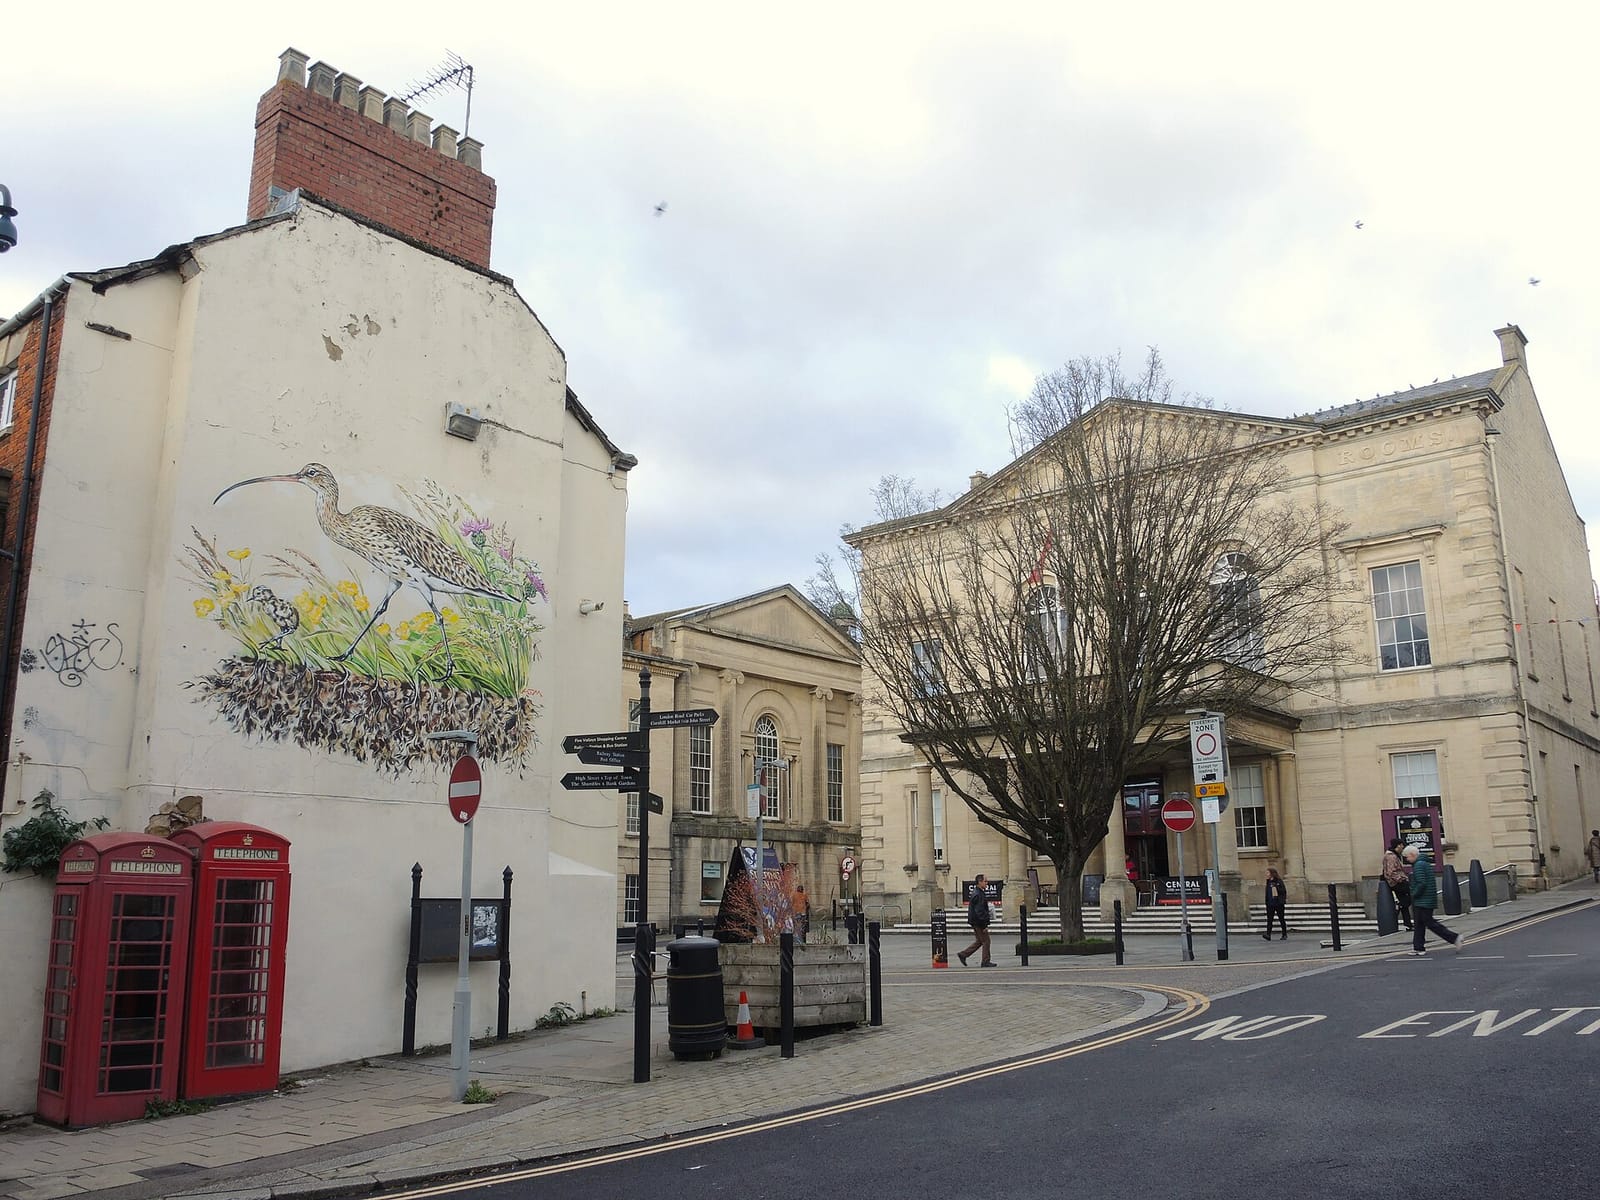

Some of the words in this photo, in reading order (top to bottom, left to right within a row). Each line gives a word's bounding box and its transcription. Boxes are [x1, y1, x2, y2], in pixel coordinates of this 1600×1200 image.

[1195, 724, 1214, 732] ZONE
[218, 848, 277, 859] TELEPHONE
[66, 861, 95, 872] TELEPHONE
[113, 861, 178, 873] TELEPHONE
[1165, 880, 1200, 888] CENRAL
[1156, 1014, 1327, 1041] NO
